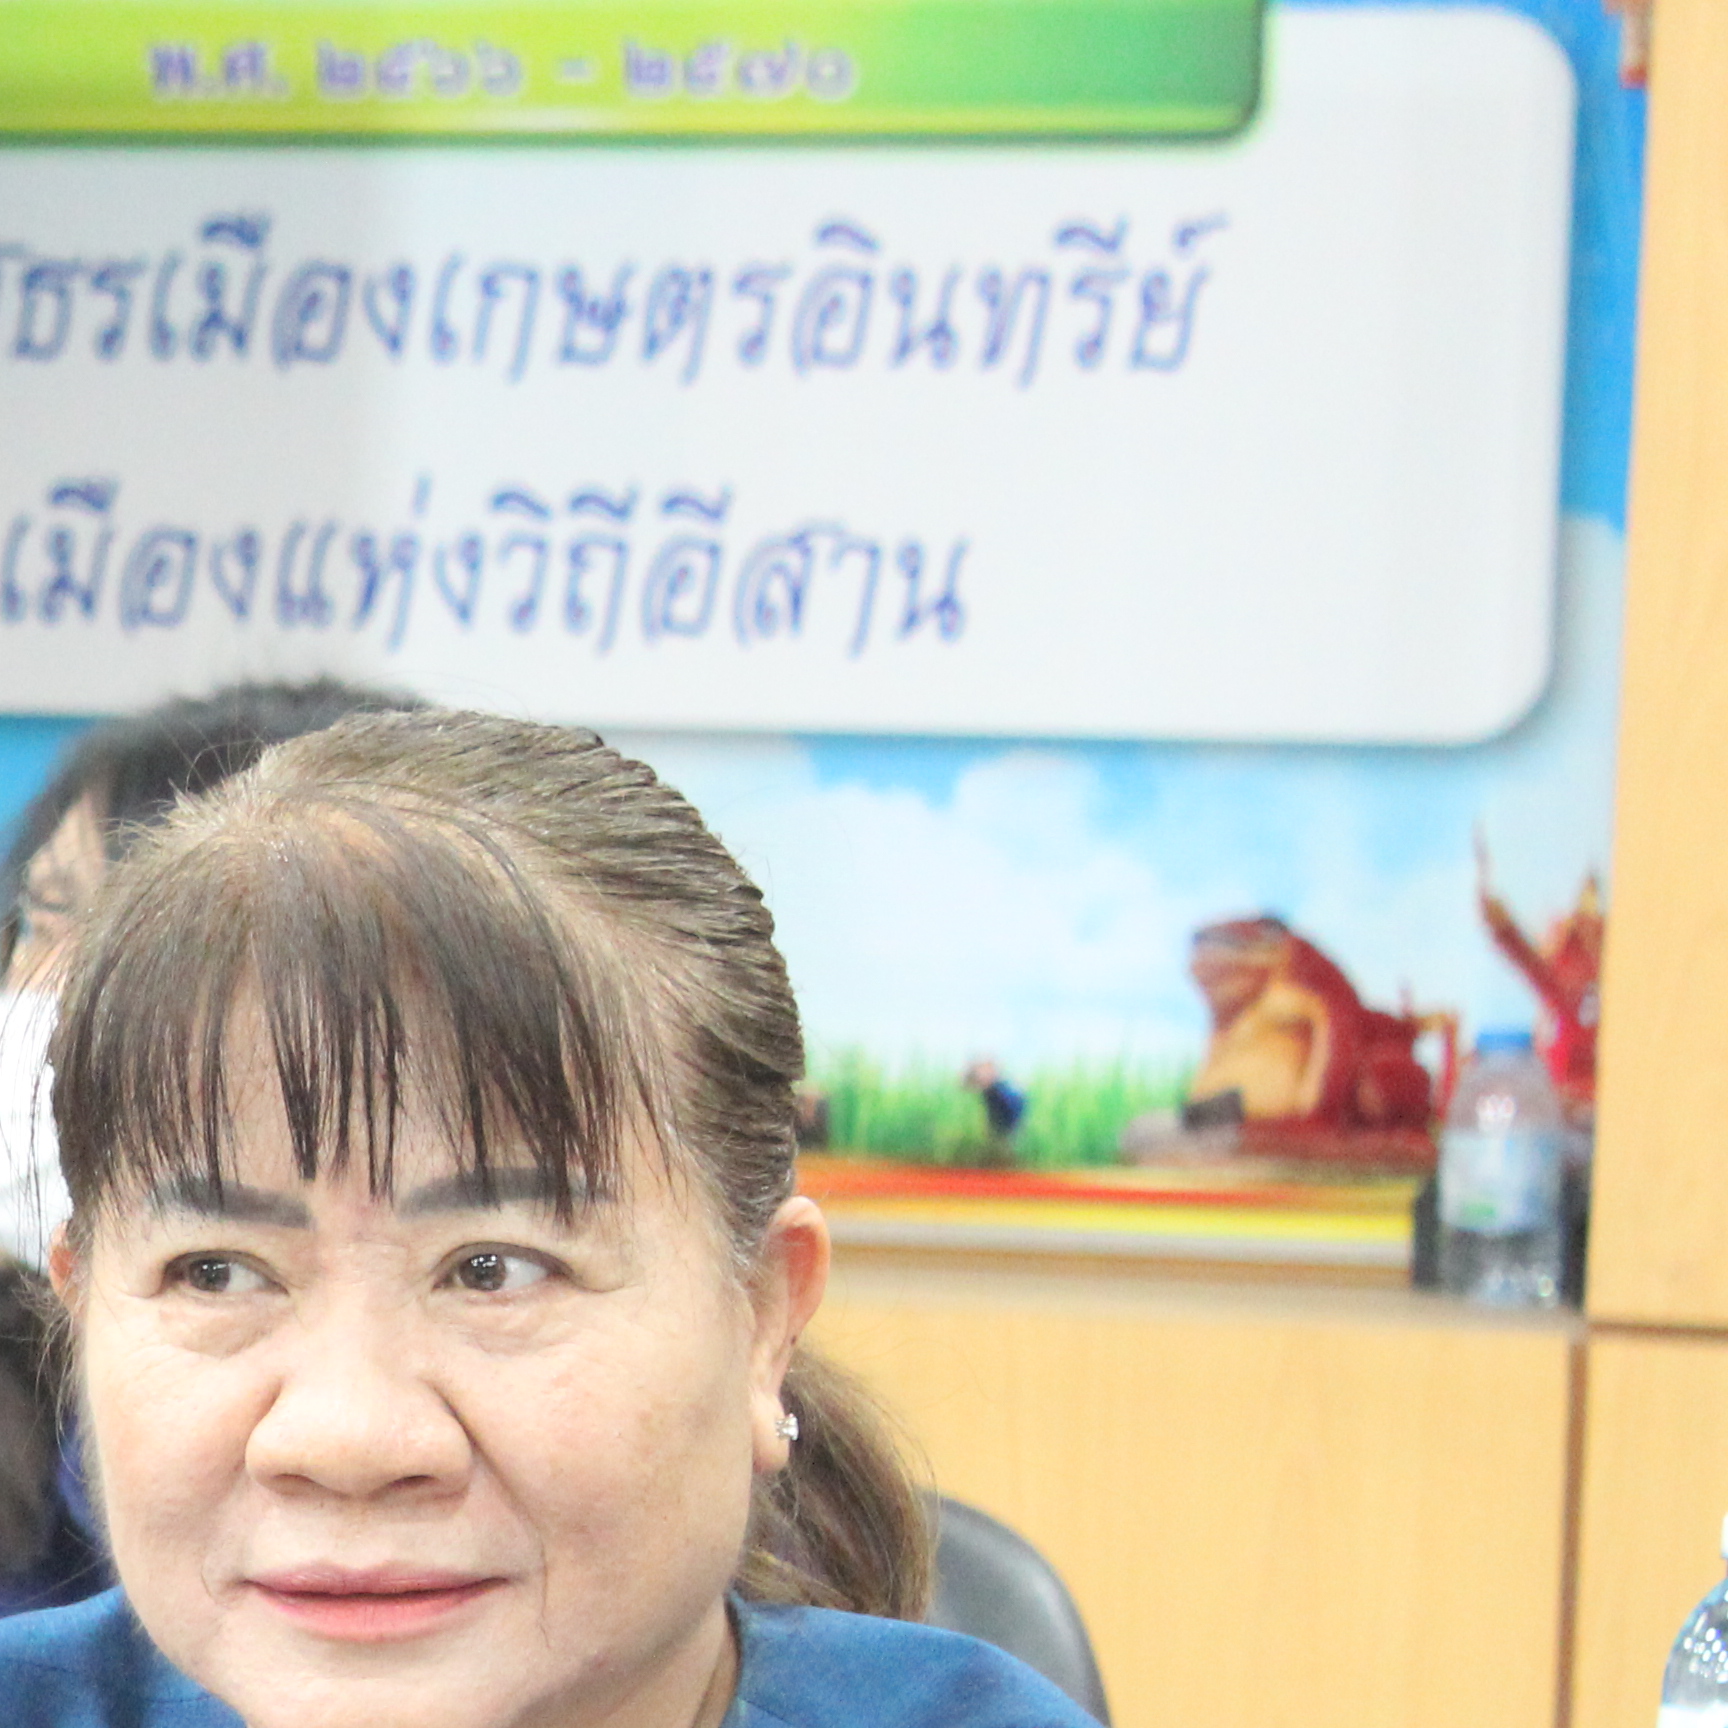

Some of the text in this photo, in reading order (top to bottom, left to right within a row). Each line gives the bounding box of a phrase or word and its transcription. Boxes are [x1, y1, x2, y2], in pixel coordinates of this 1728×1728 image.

[151, 38, 289, 99] พ.ศ.
[314, 40, 524, 98] ๒๕๖๖
[623, 38, 856, 97] ๒๕๗๐
